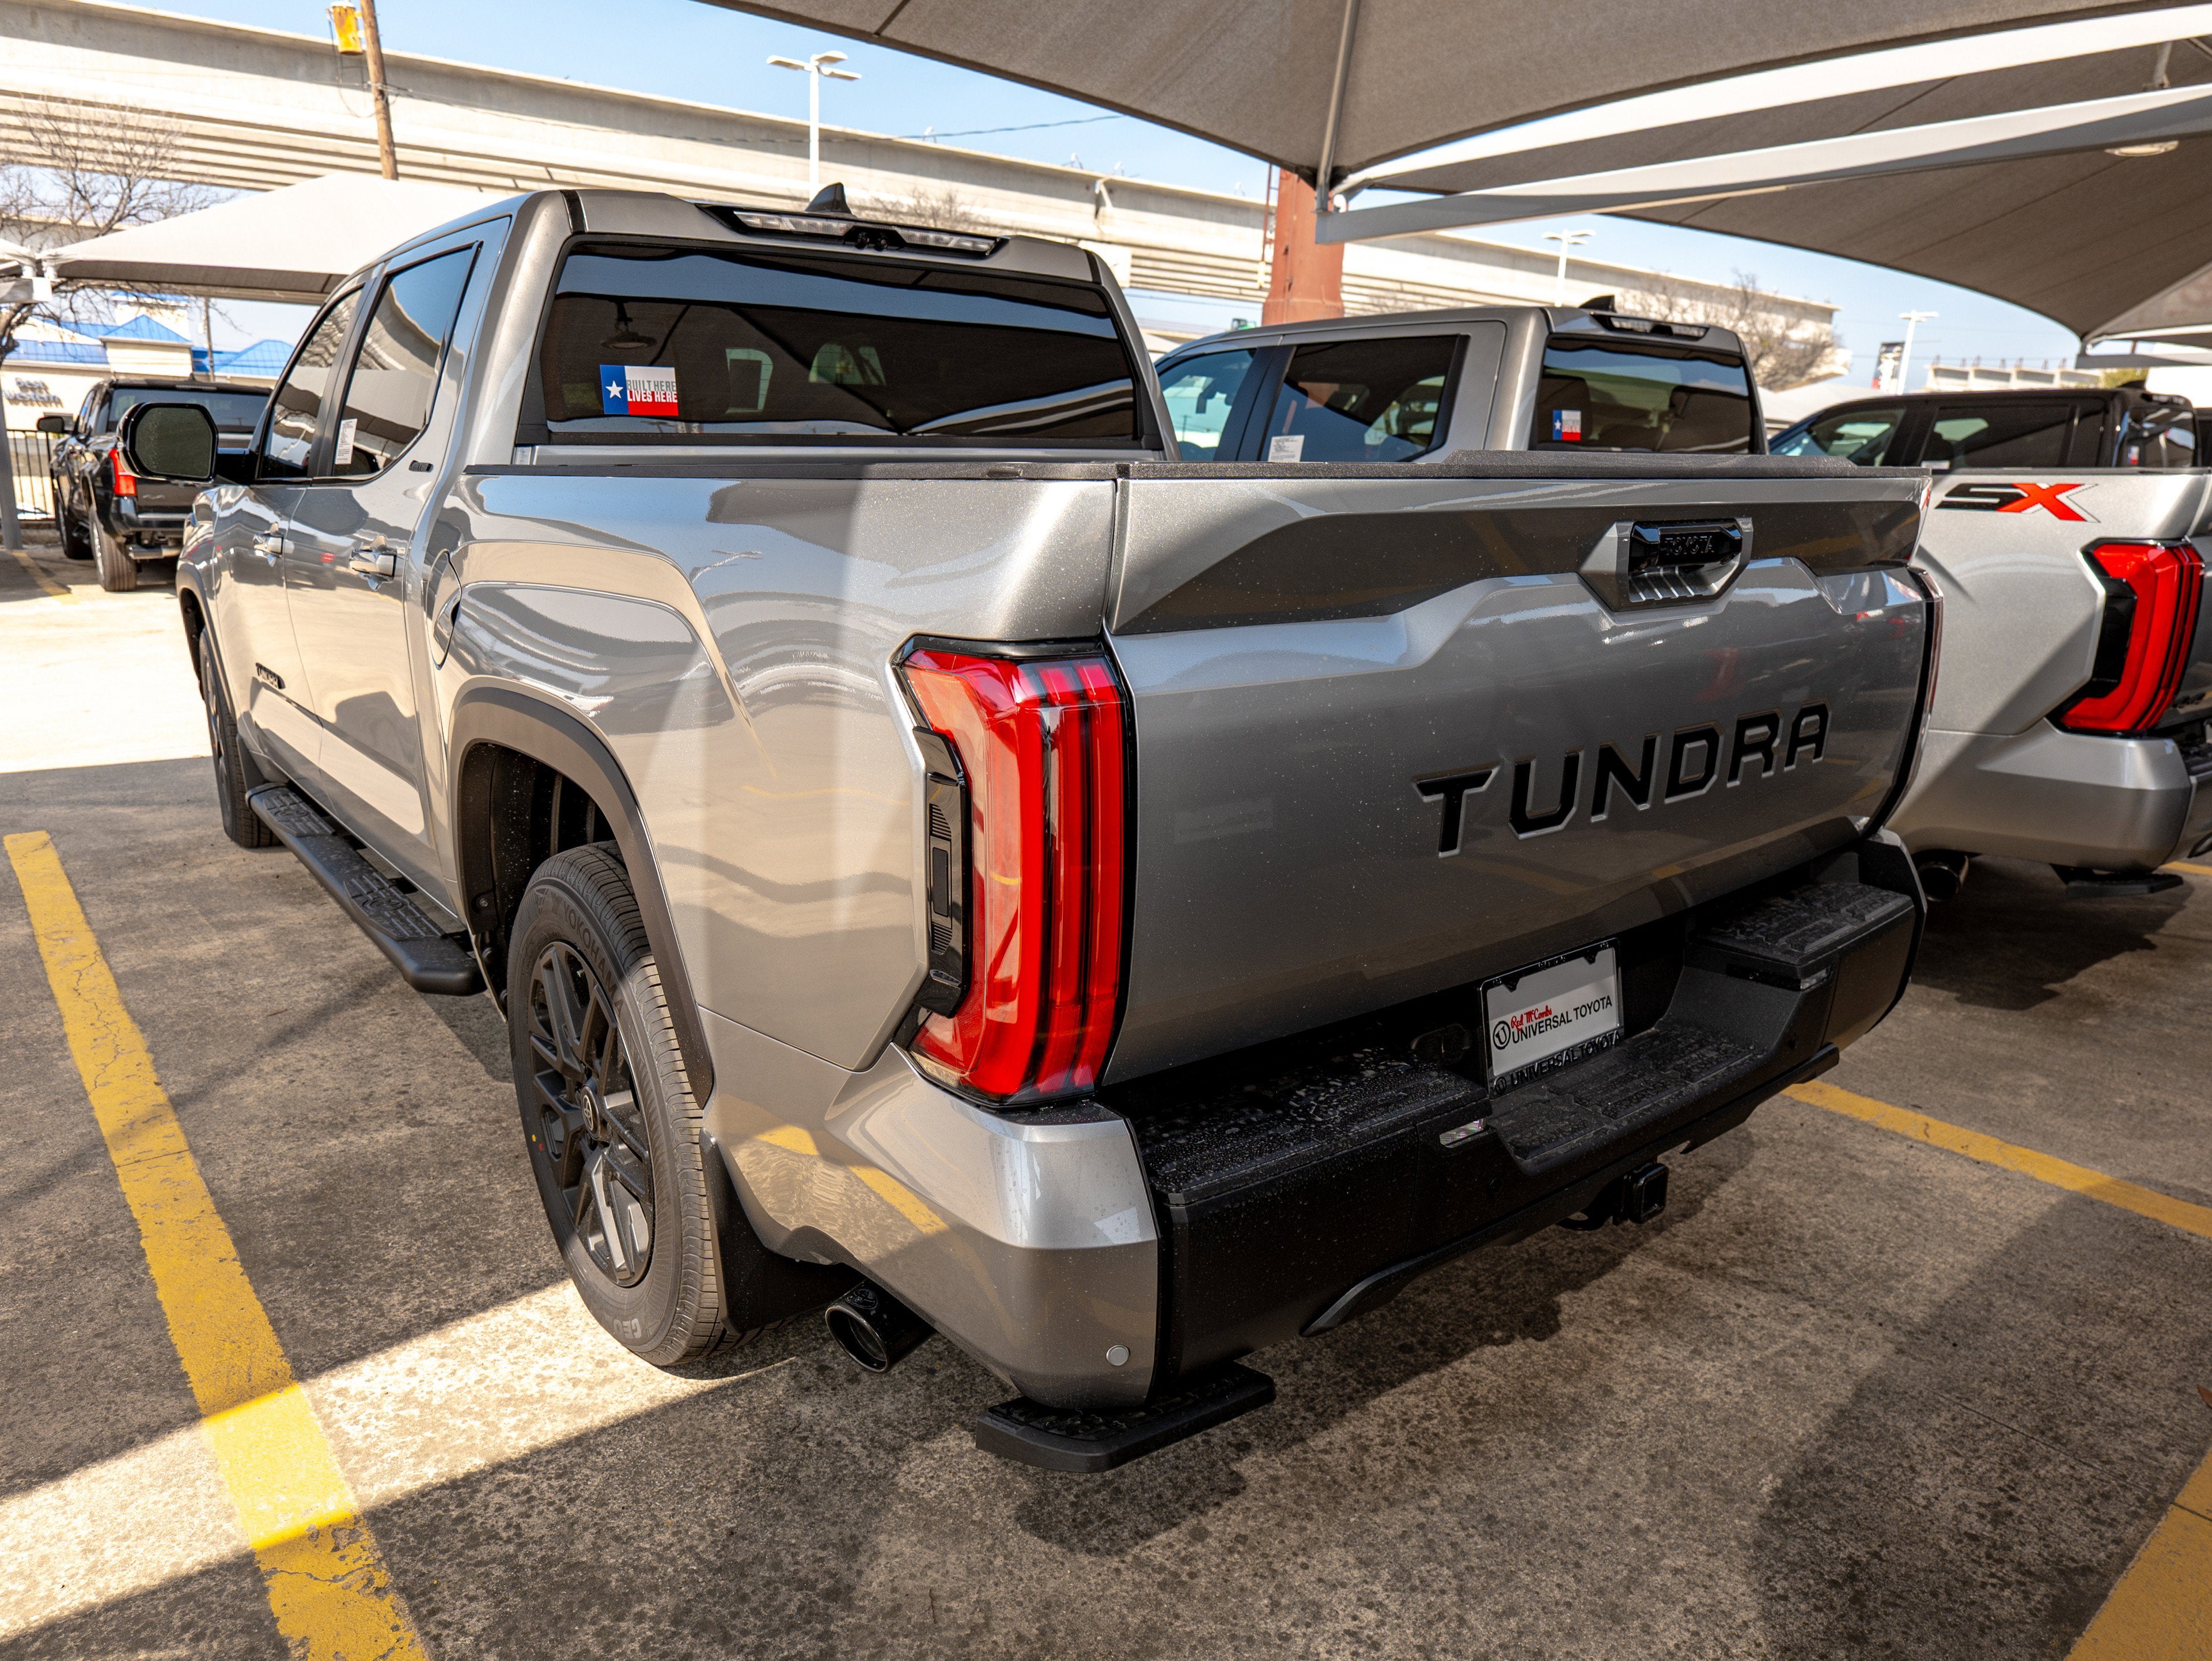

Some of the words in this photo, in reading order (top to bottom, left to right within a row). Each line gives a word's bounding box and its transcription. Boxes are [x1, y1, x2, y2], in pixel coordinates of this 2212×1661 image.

[626, 380, 652, 391] BUILT
[654, 381, 676, 392] HERE
[627, 390, 653, 402] LIVES
[654, 391, 677, 403] HERE
[1665, 536, 1714, 555] TOYOTA
[1412, 698, 1831, 858] TUNDRA
[1511, 1015, 1524, 1032] Red
[1512, 1011, 1572, 1044] UNIVERSAL
[1574, 995, 1612, 1020] TOYOTA
[1510, 1047, 1578, 1085] UNIVERSAL
[1579, 1030, 1623, 1055] TOYOTA
